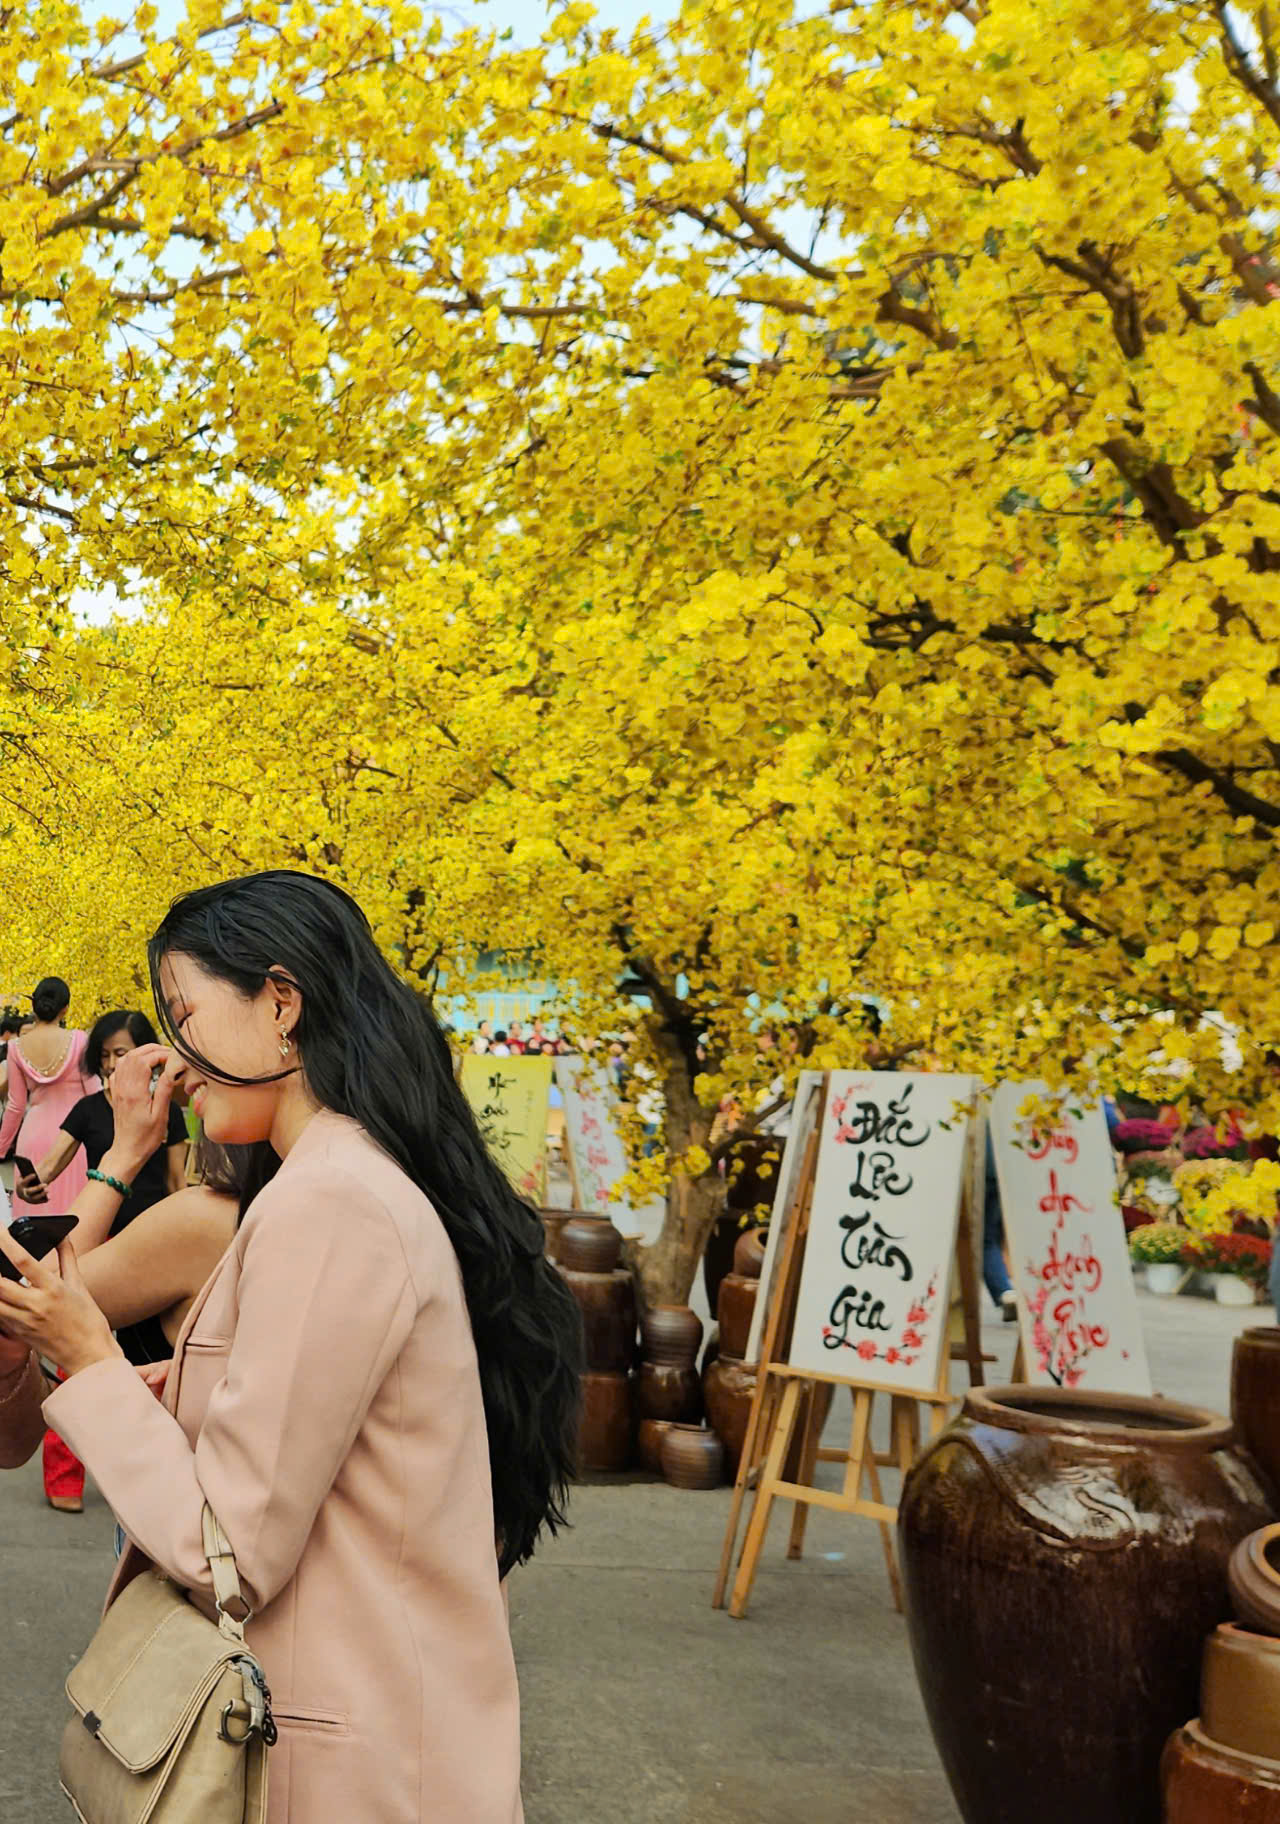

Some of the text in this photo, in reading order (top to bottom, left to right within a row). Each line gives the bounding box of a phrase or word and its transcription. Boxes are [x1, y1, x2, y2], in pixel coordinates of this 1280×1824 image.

[845, 1082, 931, 1147] Đắc
[849, 1150, 913, 1201] Lộc
[823, 1284, 894, 1350] Gia
